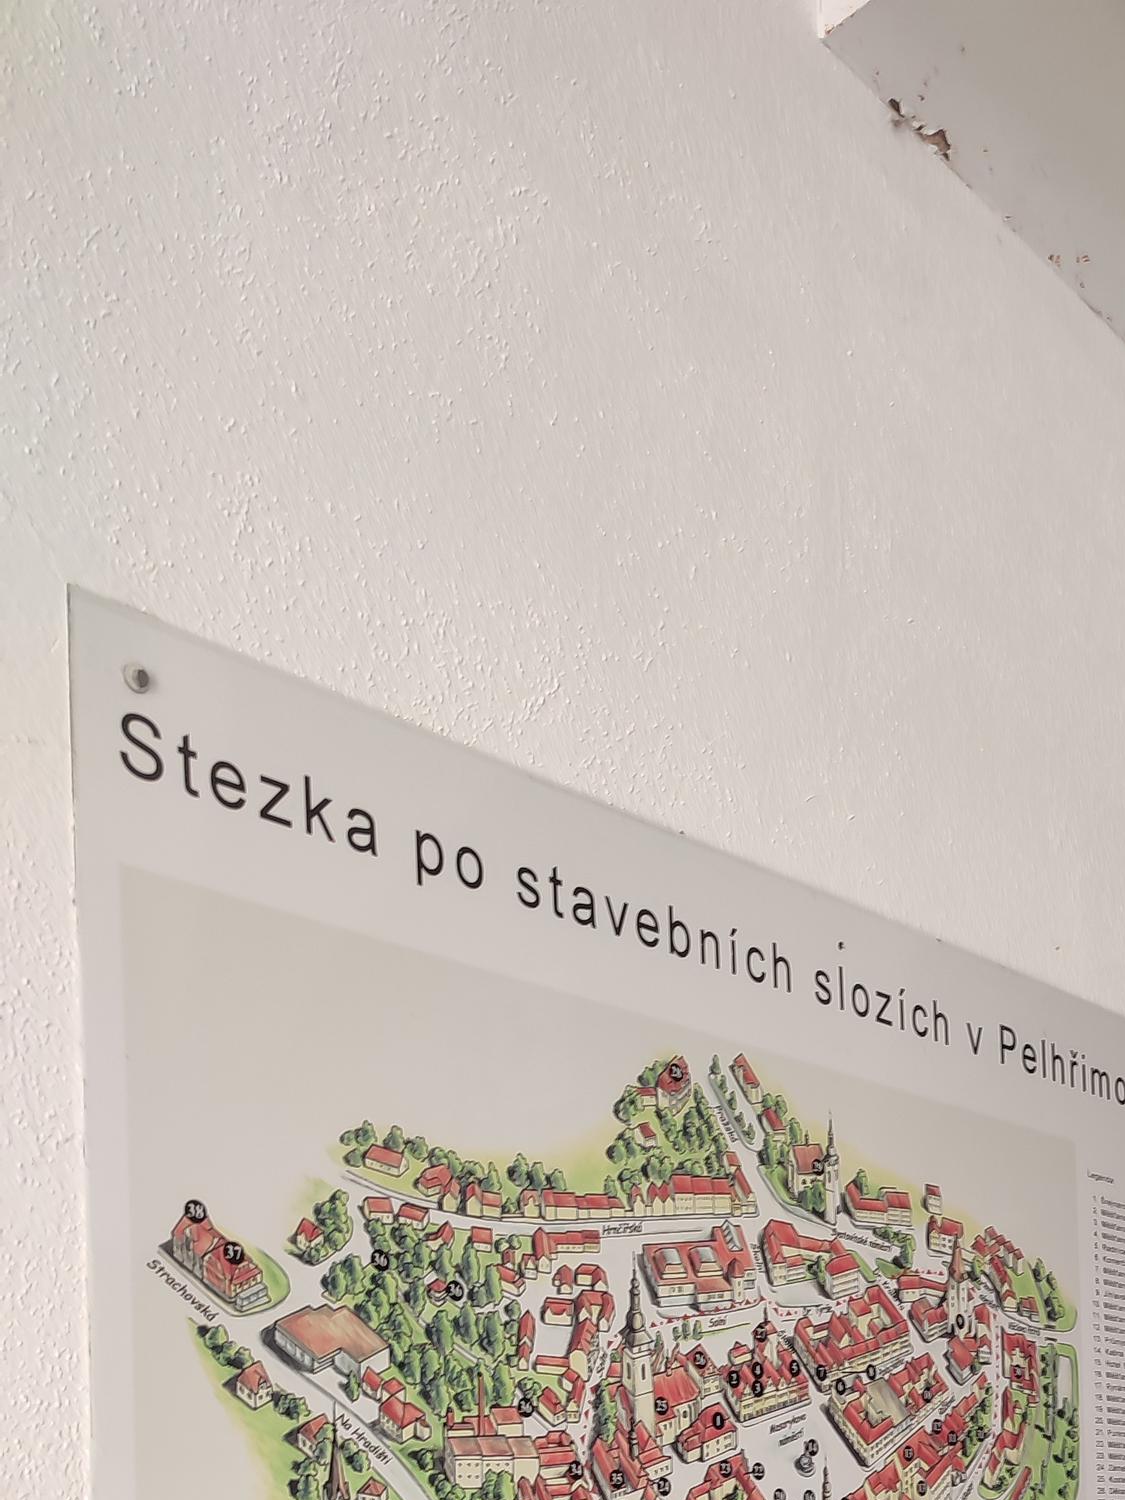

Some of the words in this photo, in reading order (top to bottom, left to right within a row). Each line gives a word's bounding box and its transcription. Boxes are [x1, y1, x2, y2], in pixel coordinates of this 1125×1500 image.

[120, 713, 378, 857] Stezka
[416, 830, 484, 889] po
[517, 866, 791, 993] stavebních
[815, 966, 949, 1045] slozích
[966, 1023, 983, 1055] v
[187, 1202, 205, 1220] 38
[225, 1244, 242, 1260] 37
[146, 1259, 219, 1322] Strachovská
